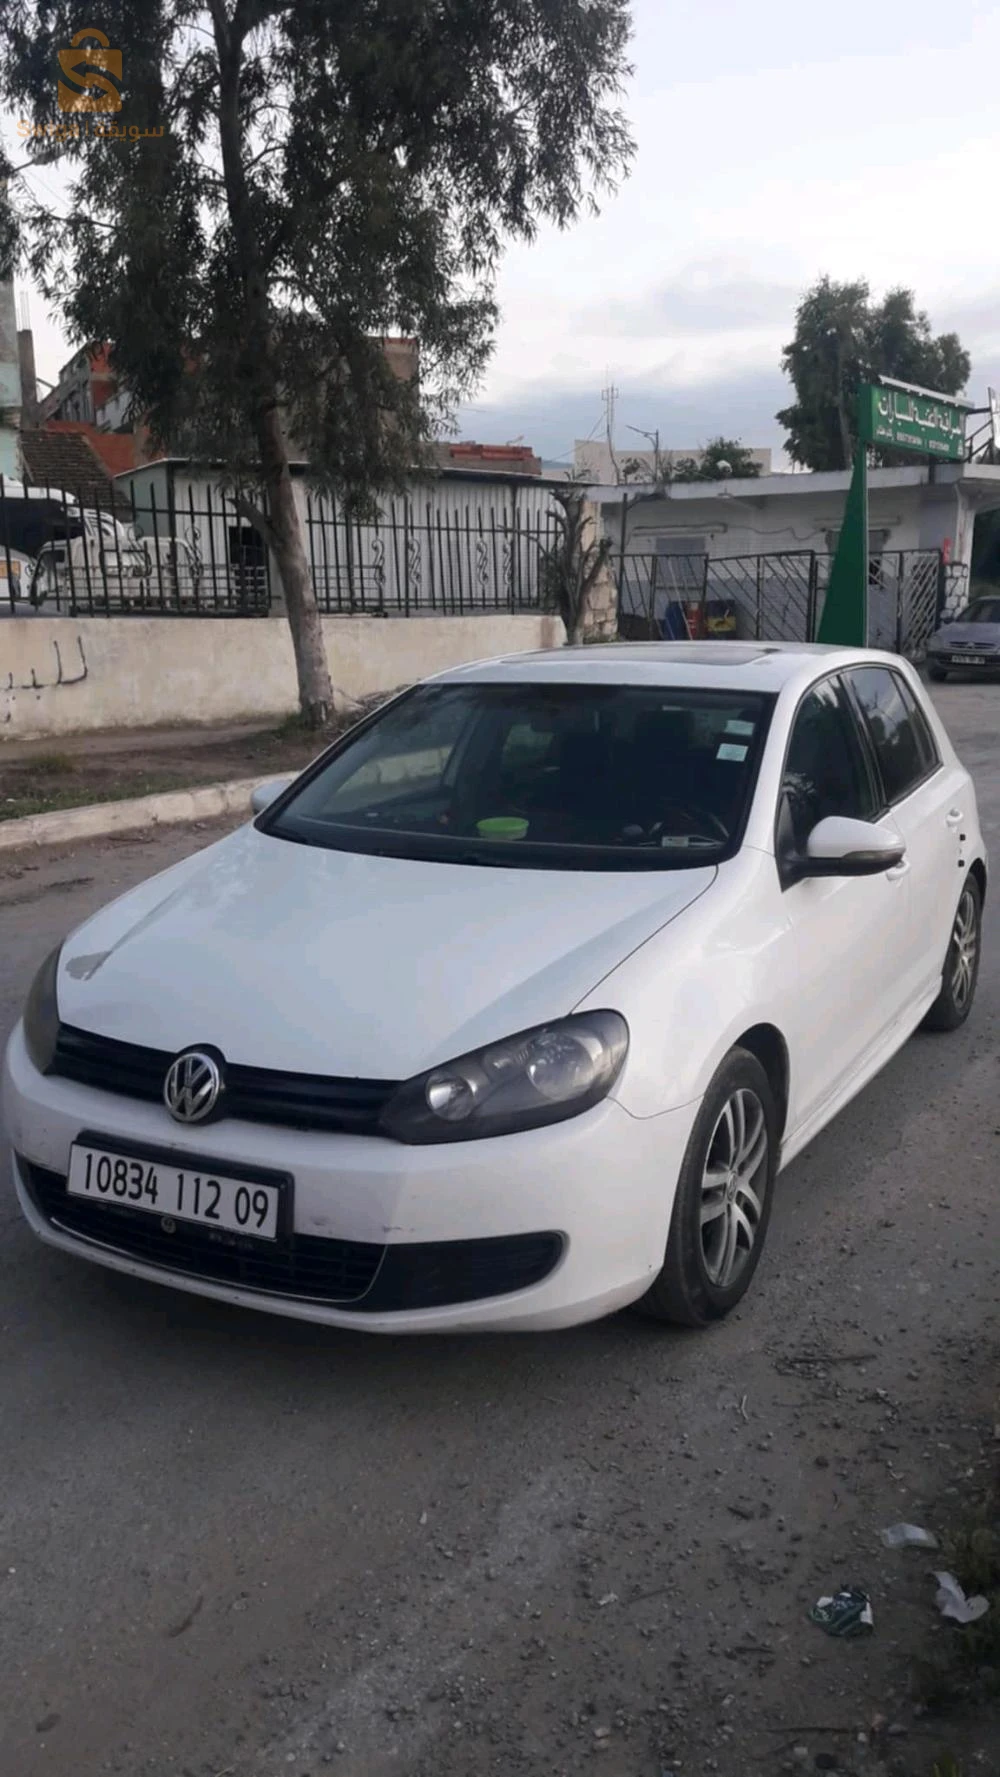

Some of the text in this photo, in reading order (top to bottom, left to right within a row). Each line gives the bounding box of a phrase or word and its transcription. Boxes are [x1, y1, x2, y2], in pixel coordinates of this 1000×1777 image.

[85, 1153, 269, 1229] 10834 112 09
